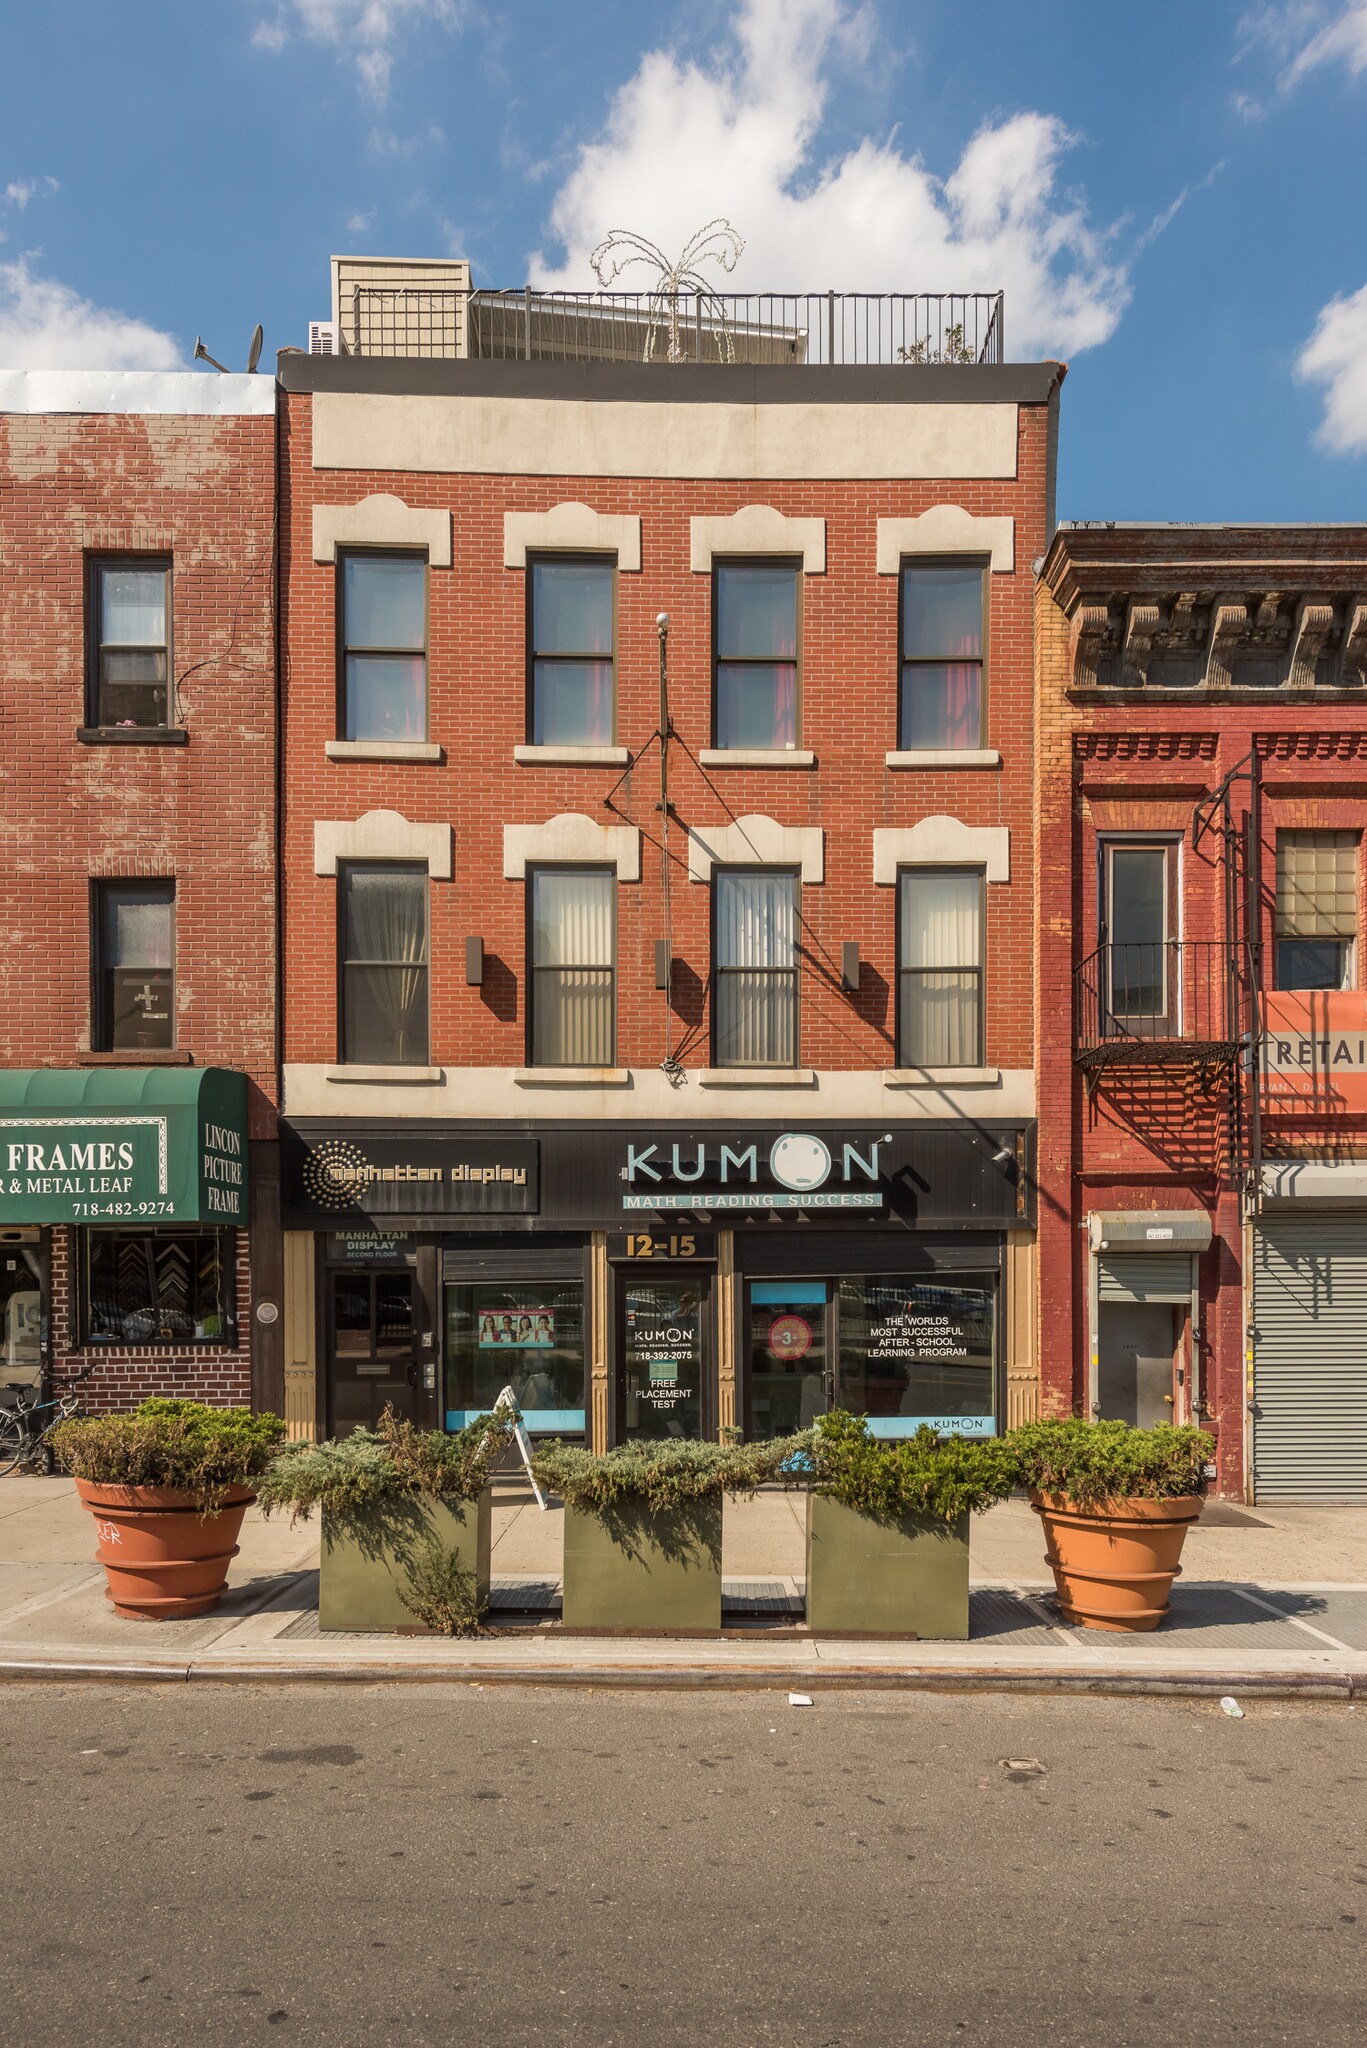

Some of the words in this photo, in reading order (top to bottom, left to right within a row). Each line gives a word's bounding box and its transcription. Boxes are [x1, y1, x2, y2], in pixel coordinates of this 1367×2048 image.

[1277, 1040, 1365, 1065] RETAI
[1260, 1083, 1287, 1092] EVAN
[1303, 1083, 1341, 1092] DANIEL
[205, 1123, 240, 1155] LINCON
[7, 1142, 134, 1171] FRAMES
[627, 1133, 880, 1191] KUMON
[204, 1154, 243, 1185] PICTURE
[329, 1165, 443, 1181] manhattan
[452, 1165, 527, 1185] display
[9, 1178, 22, 1194] &
[27, 1178, 85, 1194] METAL
[90, 1177, 133, 1193] LEAF
[207, 1186, 240, 1213] FRAME
[627, 1196, 683, 1208] MATH.
[691, 1195, 780, 1207] READING.
[788, 1194, 881, 1206] SUCCESS.
[72, 1201, 175, 1216] 718-482-9274
[335, 1231, 408, 1240] MANHATTAN
[347, 1241, 396, 1250] DISPLAY
[627, 1234, 696, 1257] 12-15
[885, 1317, 904, 1326] THE
[907, 1317, 949, 1326] WORLDS
[634, 1328, 695, 1343] KUMON
[870, 1328, 898, 1337] MOST
[901, 1327, 964, 1336] SUCCESSFUL
[634, 1351, 692, 1360] 718-392-2075
[867, 1349, 915, 1357] LEARNING
[919, 1348, 967, 1356] PROGRAM
[651, 1379, 676, 1388] FREE
[635, 1389, 692, 1398] PLACEMENT
[652, 1400, 676, 1408] TEST
[934, 1418, 984, 1430] KUMON
